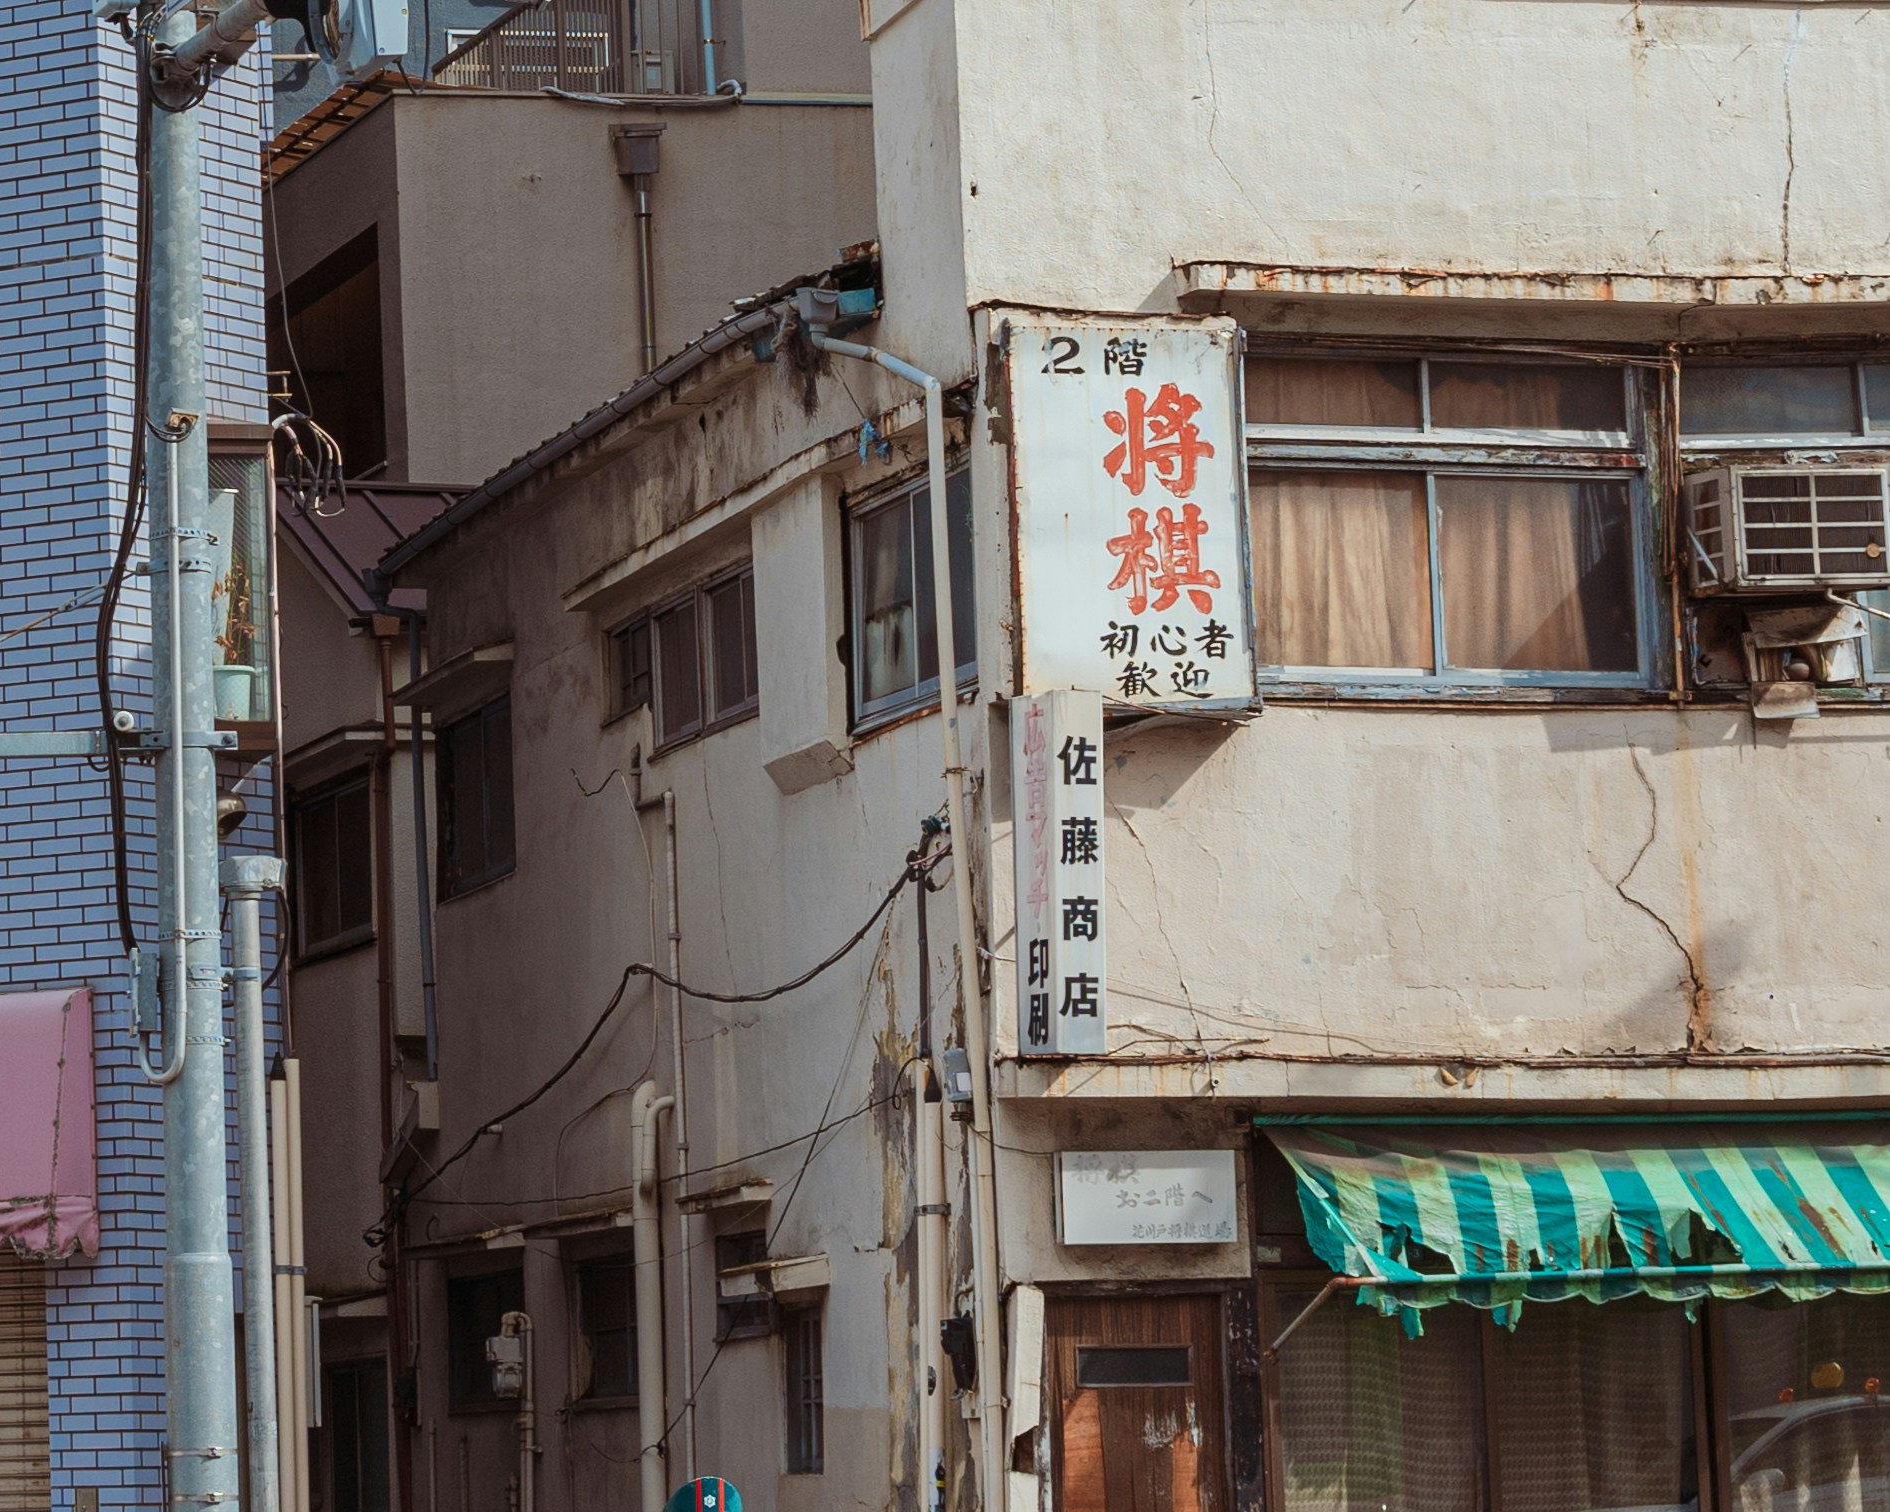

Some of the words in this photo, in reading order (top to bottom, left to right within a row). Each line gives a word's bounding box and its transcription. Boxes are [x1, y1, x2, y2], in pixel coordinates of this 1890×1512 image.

[1041, 336, 1148, 377] 2階
[1102, 382, 1221, 616] 将棋
[1100, 619, 1234, 659] 初心者
[1116, 660, 1215, 698] 歓迎
[1057, 735, 1099, 1018] 佐藤商店
[1115, 1183, 1213, 1209] お二階へ
[1132, 1221, 1233, 1240] 花川戸将棋道場
